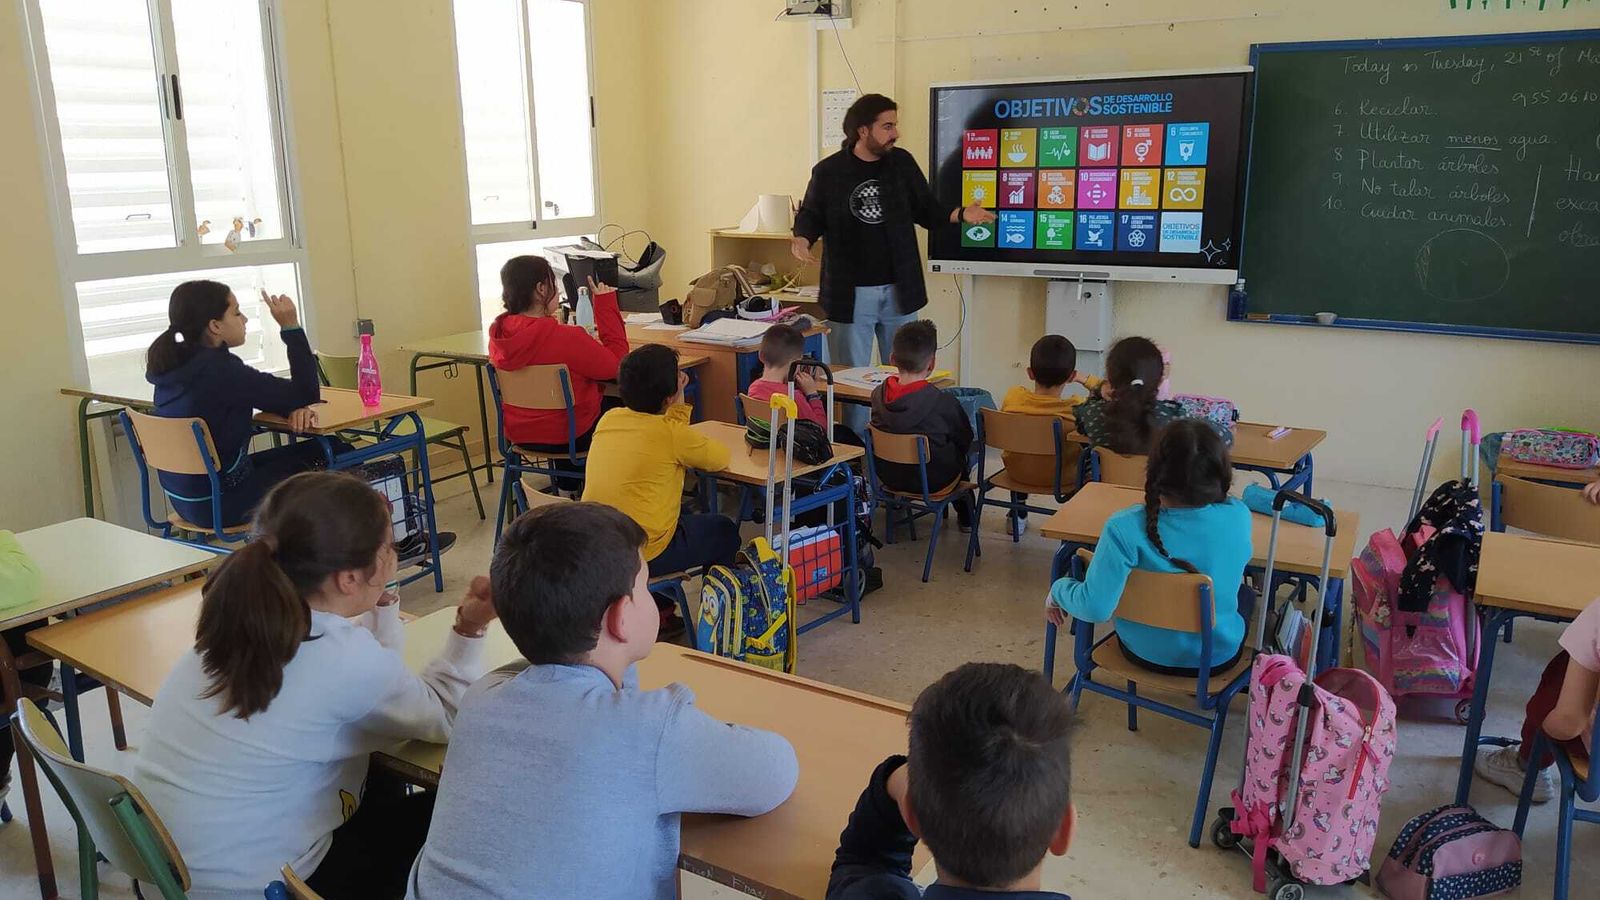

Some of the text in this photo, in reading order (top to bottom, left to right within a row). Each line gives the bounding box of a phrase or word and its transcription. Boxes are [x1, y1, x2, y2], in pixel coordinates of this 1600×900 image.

[1341, 55, 1391, 85] Today
[1546, 47, 1565, 77] of
[1103, 93, 1173, 104] DE DESARROLLO
[994, 96, 1103, 119] OBJETIVOS
[1103, 102, 1173, 115] SOSTENIBLE
[1042, 130, 1048, 140] 3
[1084, 129, 1090, 139] 4
[1126, 128, 1132, 138] 5
[1170, 126, 1177, 137] 6
[1360, 121, 1432, 145] Utilizar
[1447, 133, 1499, 146] menos
[1356, 148, 1425, 171] Plantar
[1080, 172, 1089, 182] 10
[1123, 172, 1130, 181] 11
[1167, 171, 1175, 181] 12
[1361, 176, 1382, 196] No
[1001, 213, 1008, 223] 14
[1040, 213, 1047, 223] 15
[1080, 214, 1087, 224] 16
[1122, 214, 1128, 224] 17
